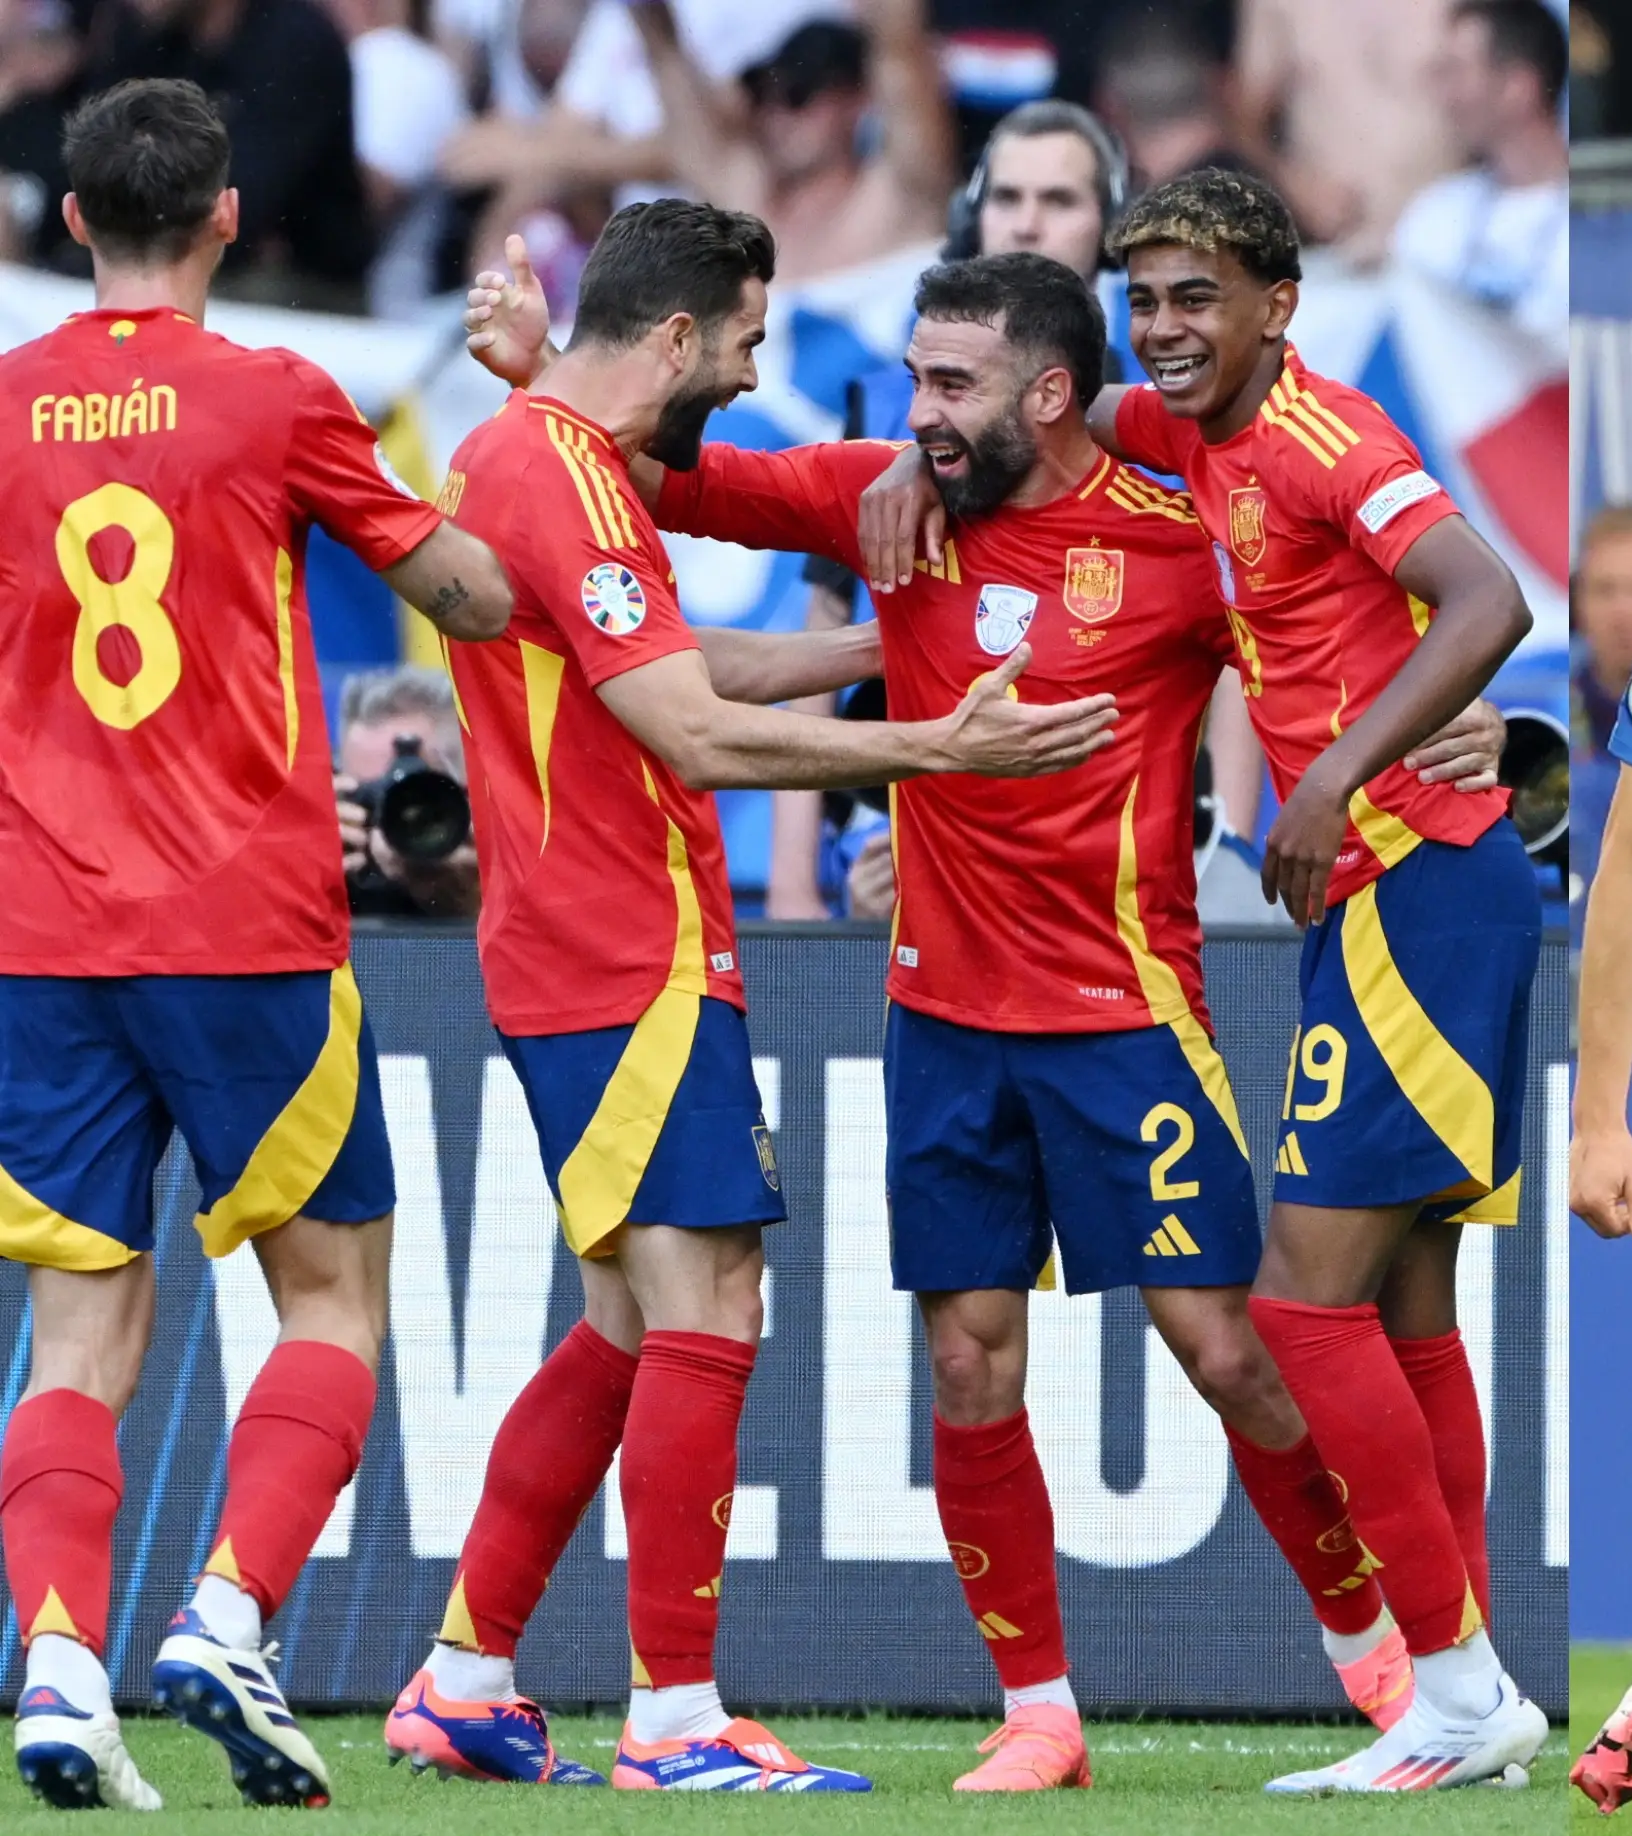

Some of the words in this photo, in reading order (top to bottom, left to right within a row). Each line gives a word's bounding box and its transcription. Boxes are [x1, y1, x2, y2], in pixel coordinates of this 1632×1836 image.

[31, 378, 177, 443] FABIÁN
[55, 481, 182, 731] 8
[1283, 1023, 1349, 1122] 19
[1140, 1103, 1200, 1201] 2
